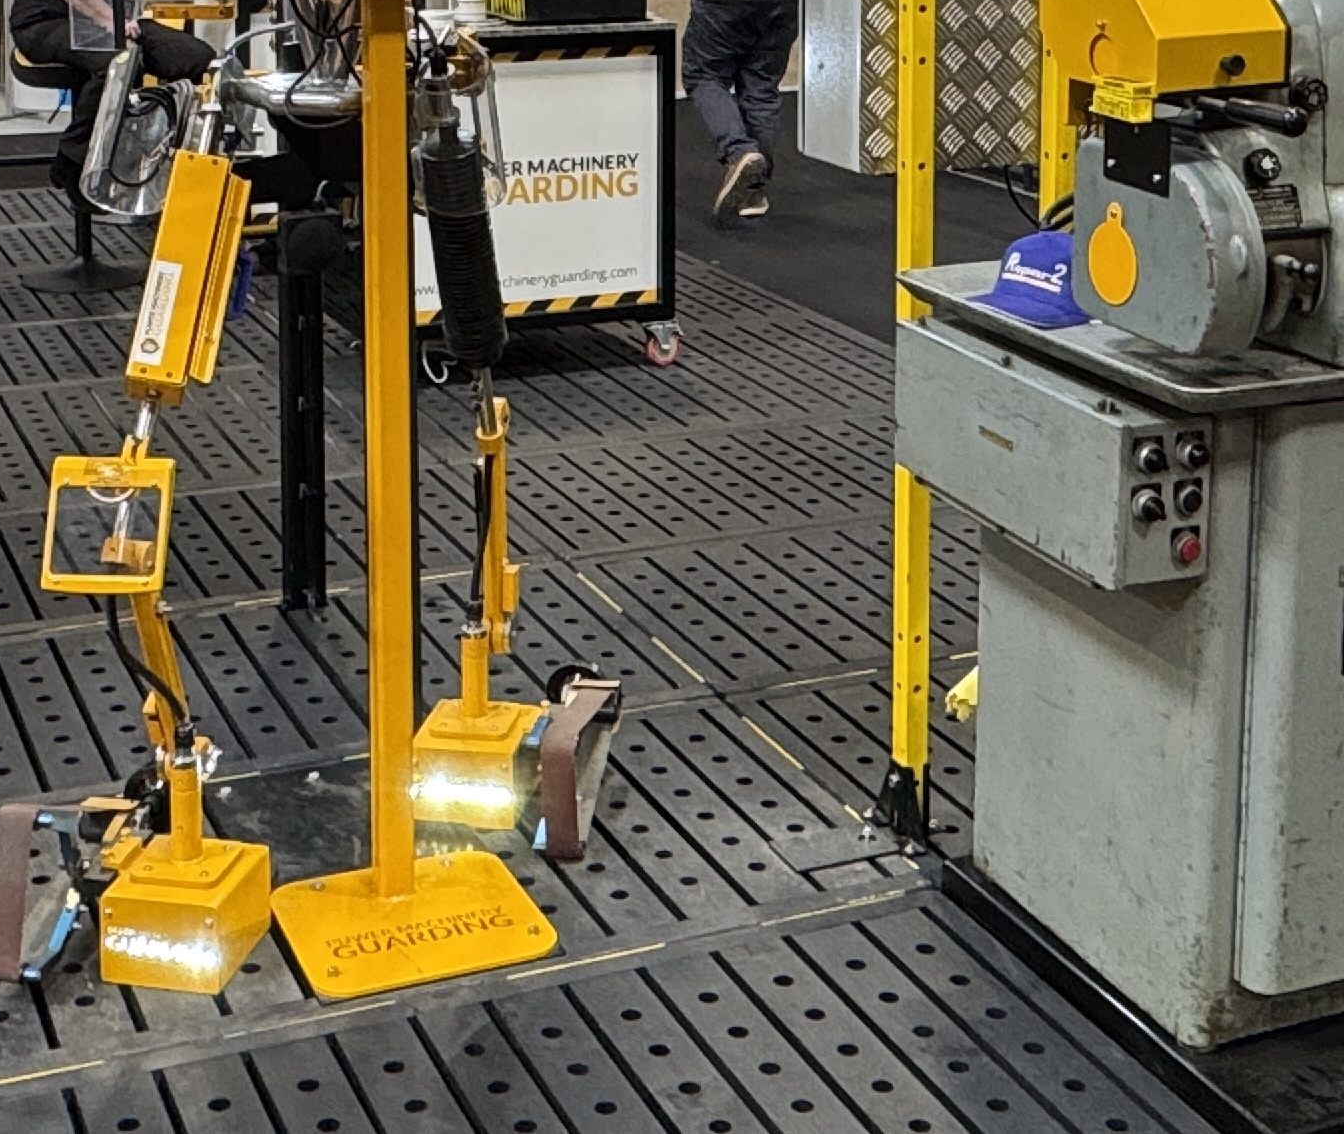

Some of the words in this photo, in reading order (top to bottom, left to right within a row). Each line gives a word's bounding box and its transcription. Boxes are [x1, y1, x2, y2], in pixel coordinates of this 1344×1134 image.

[527, 153, 639, 176] MACHINERY
[504, 170, 638, 205] ARDING
[332, 913, 514, 960] GUARDING
